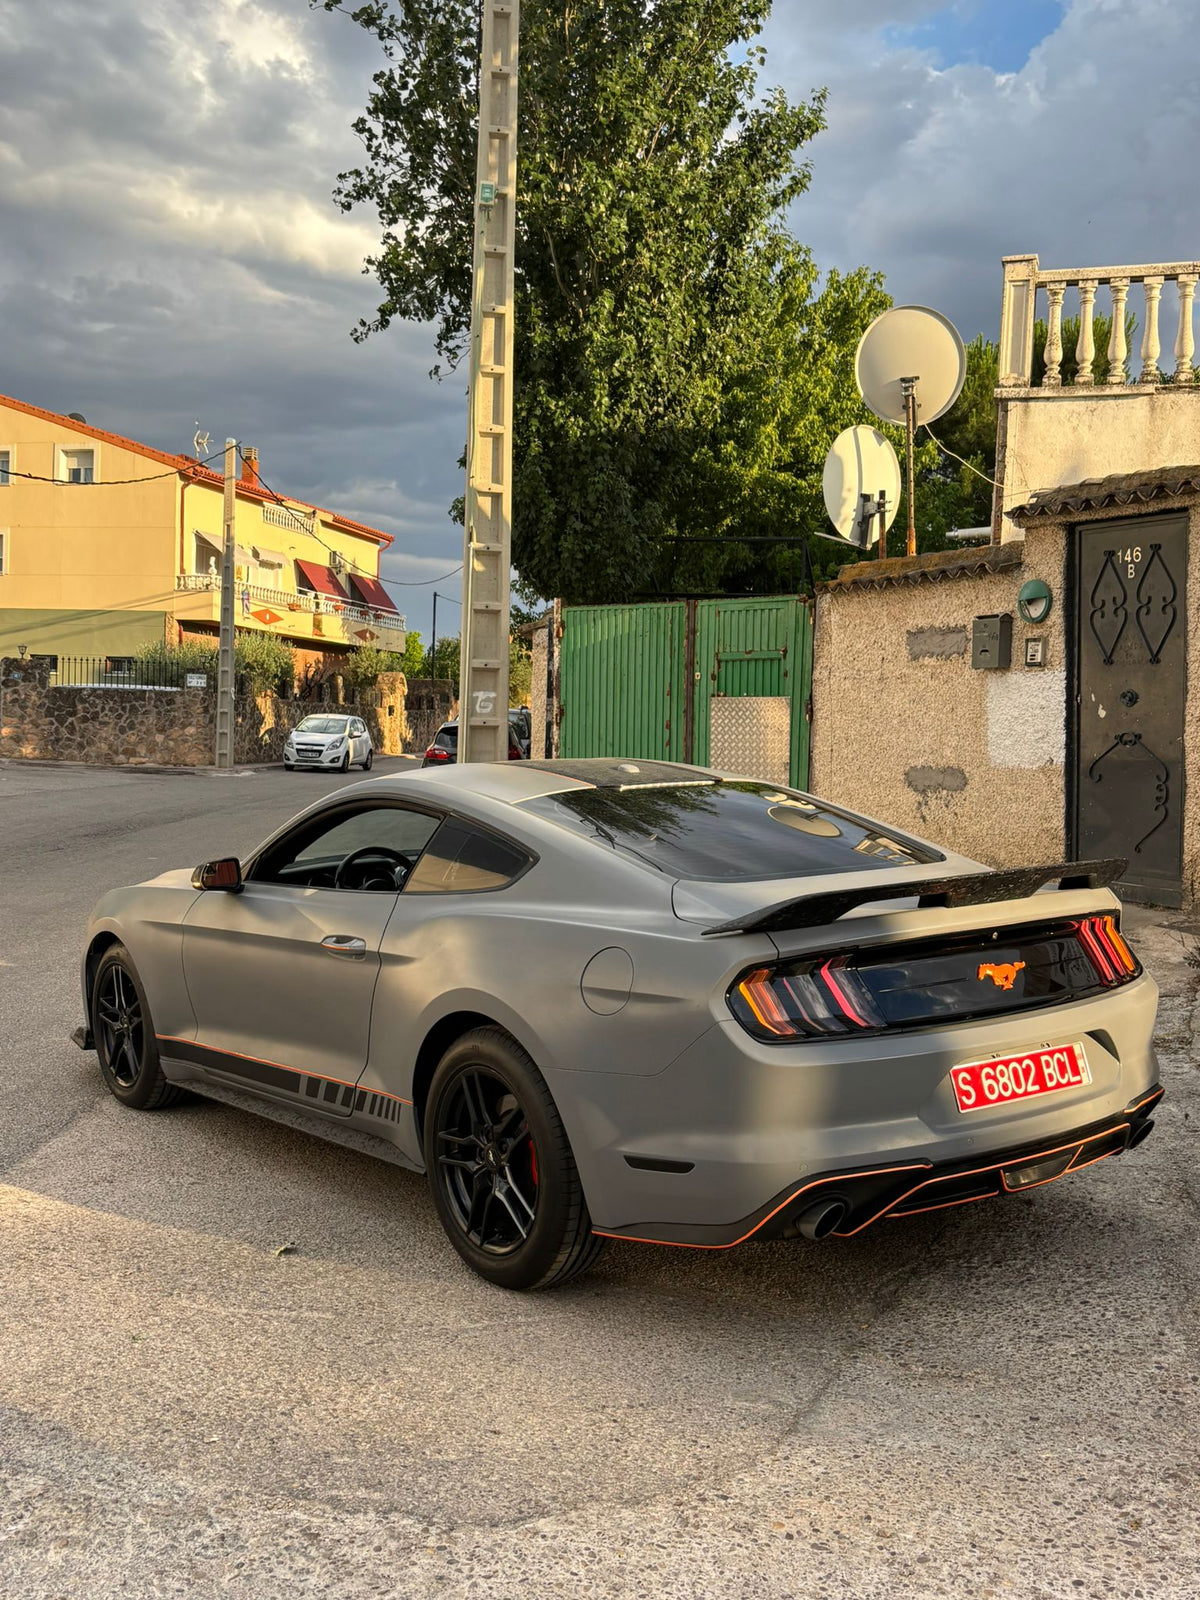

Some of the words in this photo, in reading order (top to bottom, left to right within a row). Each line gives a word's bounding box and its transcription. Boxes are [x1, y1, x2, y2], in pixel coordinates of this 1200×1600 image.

[1117, 547, 1142, 563] 146
[1127, 564, 1136, 579] B
[957, 1071, 976, 1105] S
[980, 1058, 1040, 1100] 6802
[1040, 1051, 1081, 1088] BCL
